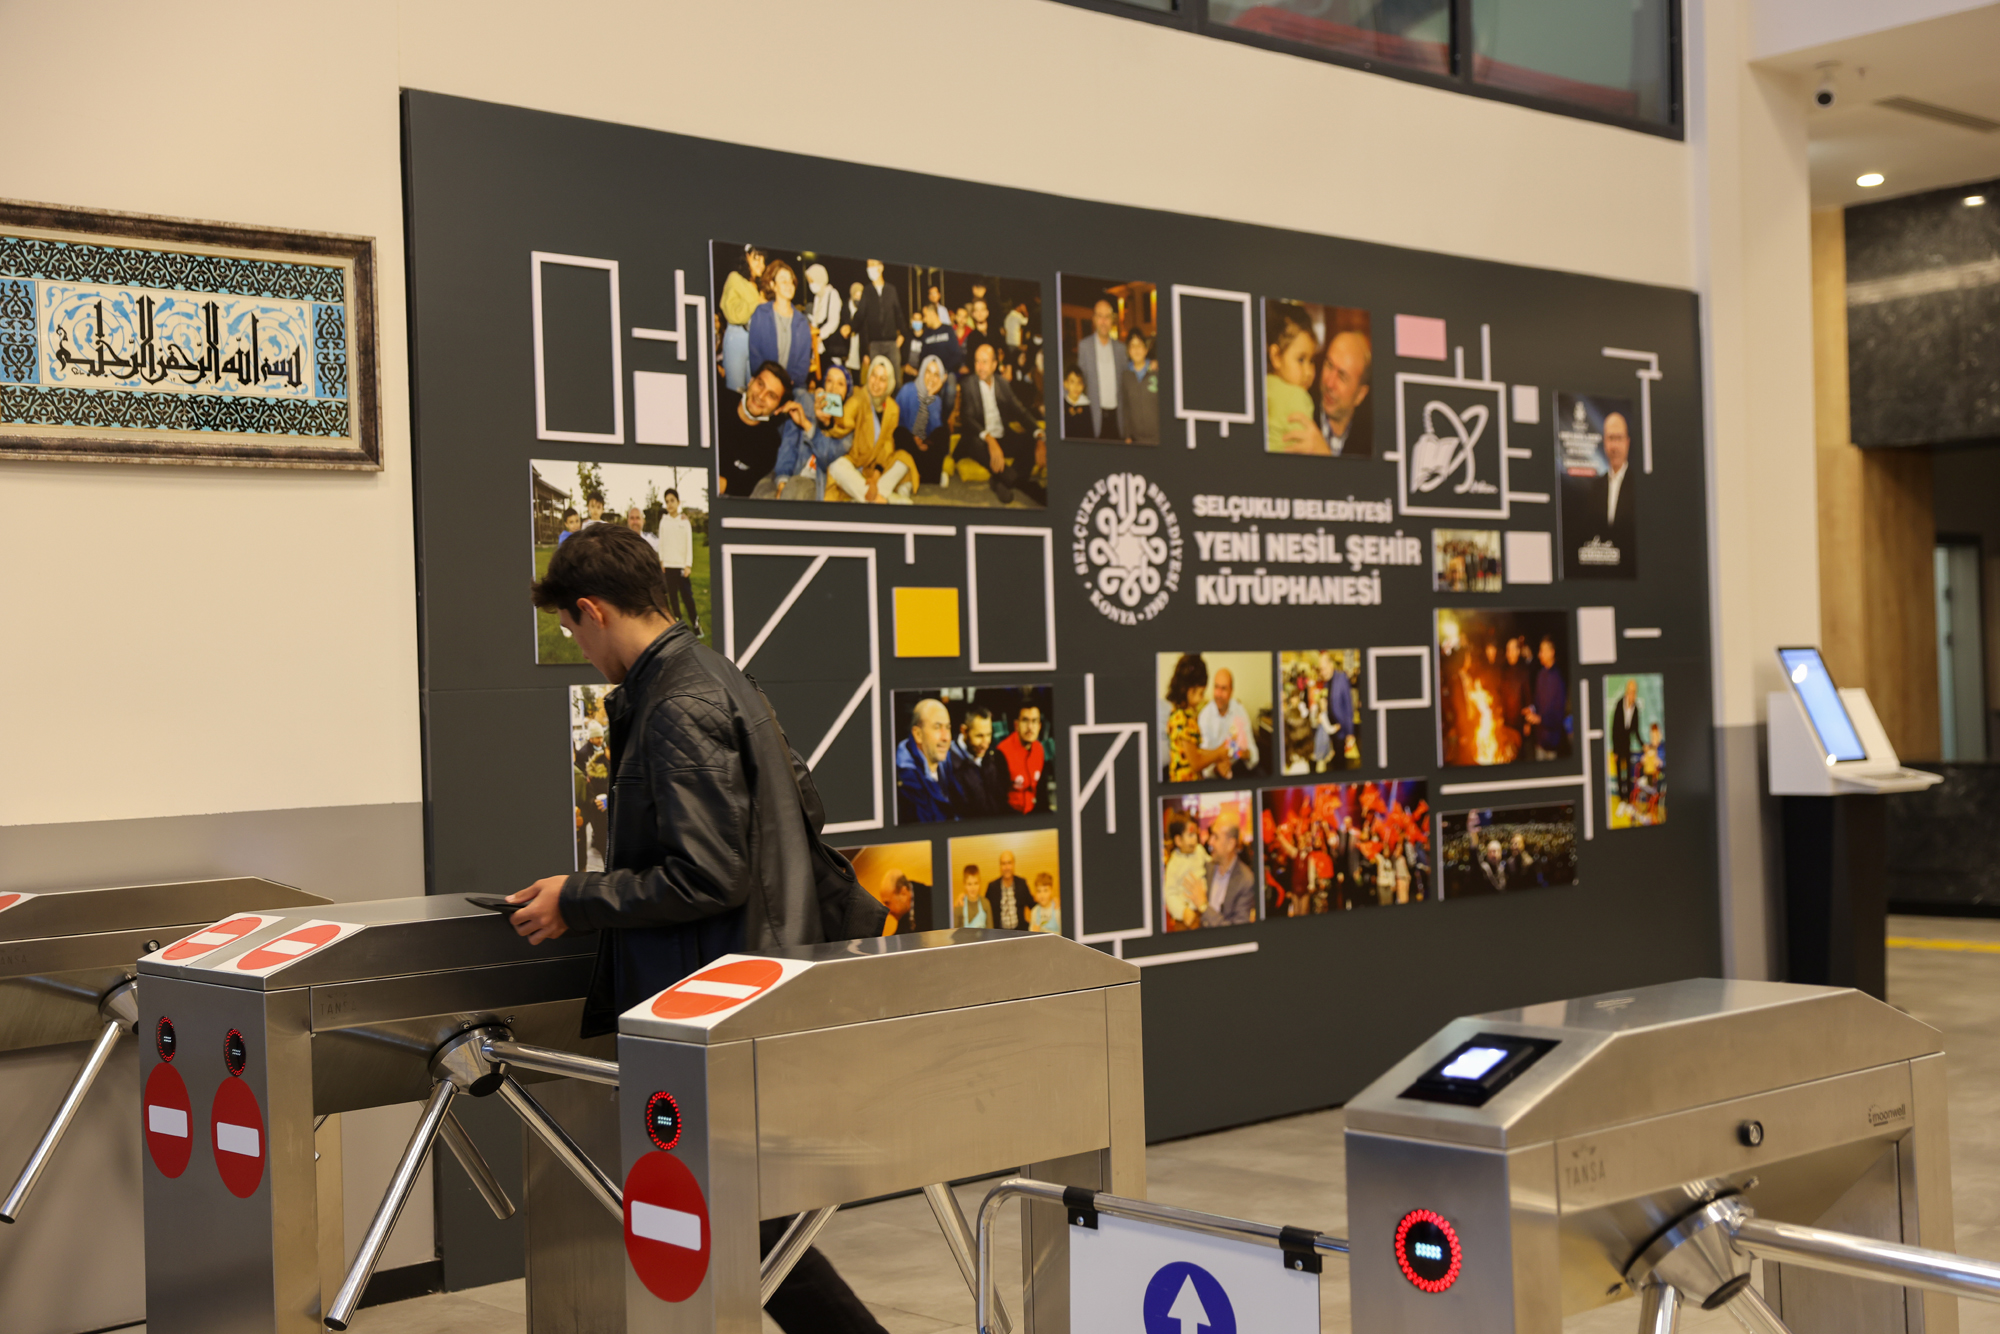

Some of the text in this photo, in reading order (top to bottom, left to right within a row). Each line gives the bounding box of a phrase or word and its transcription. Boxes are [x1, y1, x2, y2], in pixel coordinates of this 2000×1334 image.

[1193, 494, 1393, 524] SELÇUKLU BELEDİYESİ
[1193, 524, 1422, 572] YENİ NESİL ŞEHİR
[1196, 566, 1382, 606] KÜTÜPHANESİ
[1090, 589, 1137, 625] KONYA
[1565, 1159, 1606, 1189] TANSA
